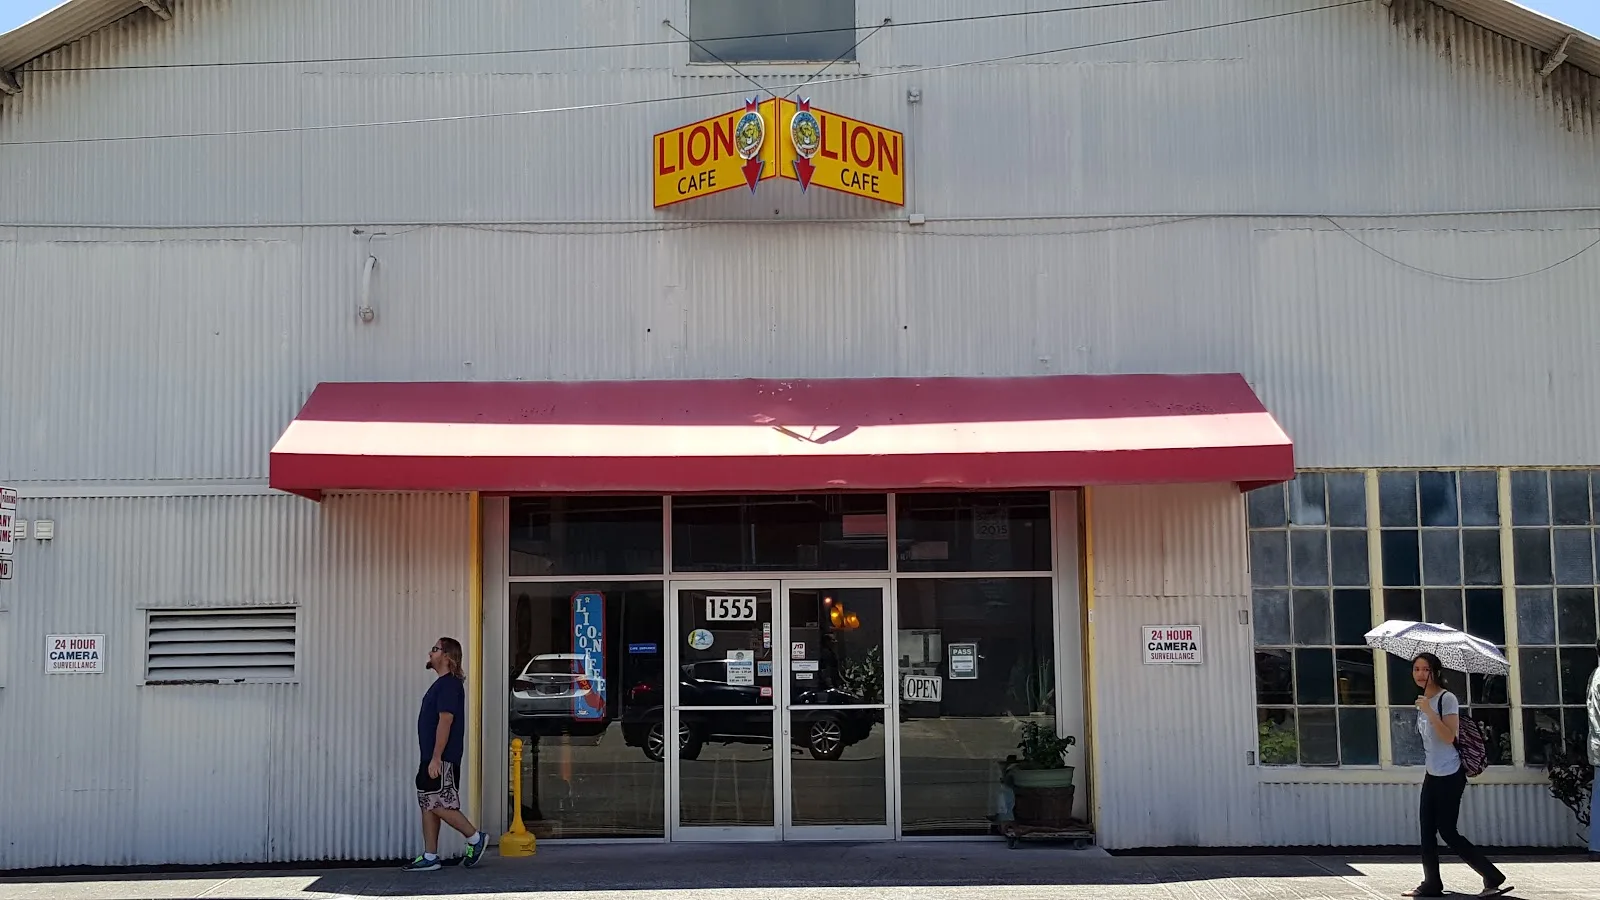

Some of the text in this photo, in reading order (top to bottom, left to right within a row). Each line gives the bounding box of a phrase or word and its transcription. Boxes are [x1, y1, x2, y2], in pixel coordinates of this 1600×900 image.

[659, 116, 734, 176] LION
[820, 115, 898, 176] LION
[677, 169, 716, 195] CAFE
[841, 168, 880, 194] CAFE
[981, 525, 1008, 535] 2015
[709, 598, 754, 619] 1555
[576, 598, 603, 653] LION
[1151, 630, 1193, 641] 24 HOUR
[54, 639, 96, 650] 24 HOUR
[1147, 642, 1198, 651] CAMERA
[49, 651, 99, 660] CAMERA
[53, 661, 97, 669] SURVEILLANCE
[575, 624, 606, 692] COFFEE
[1150, 652, 1195, 660] SURVEILLANCE
[907, 678, 939, 699] OPEN
